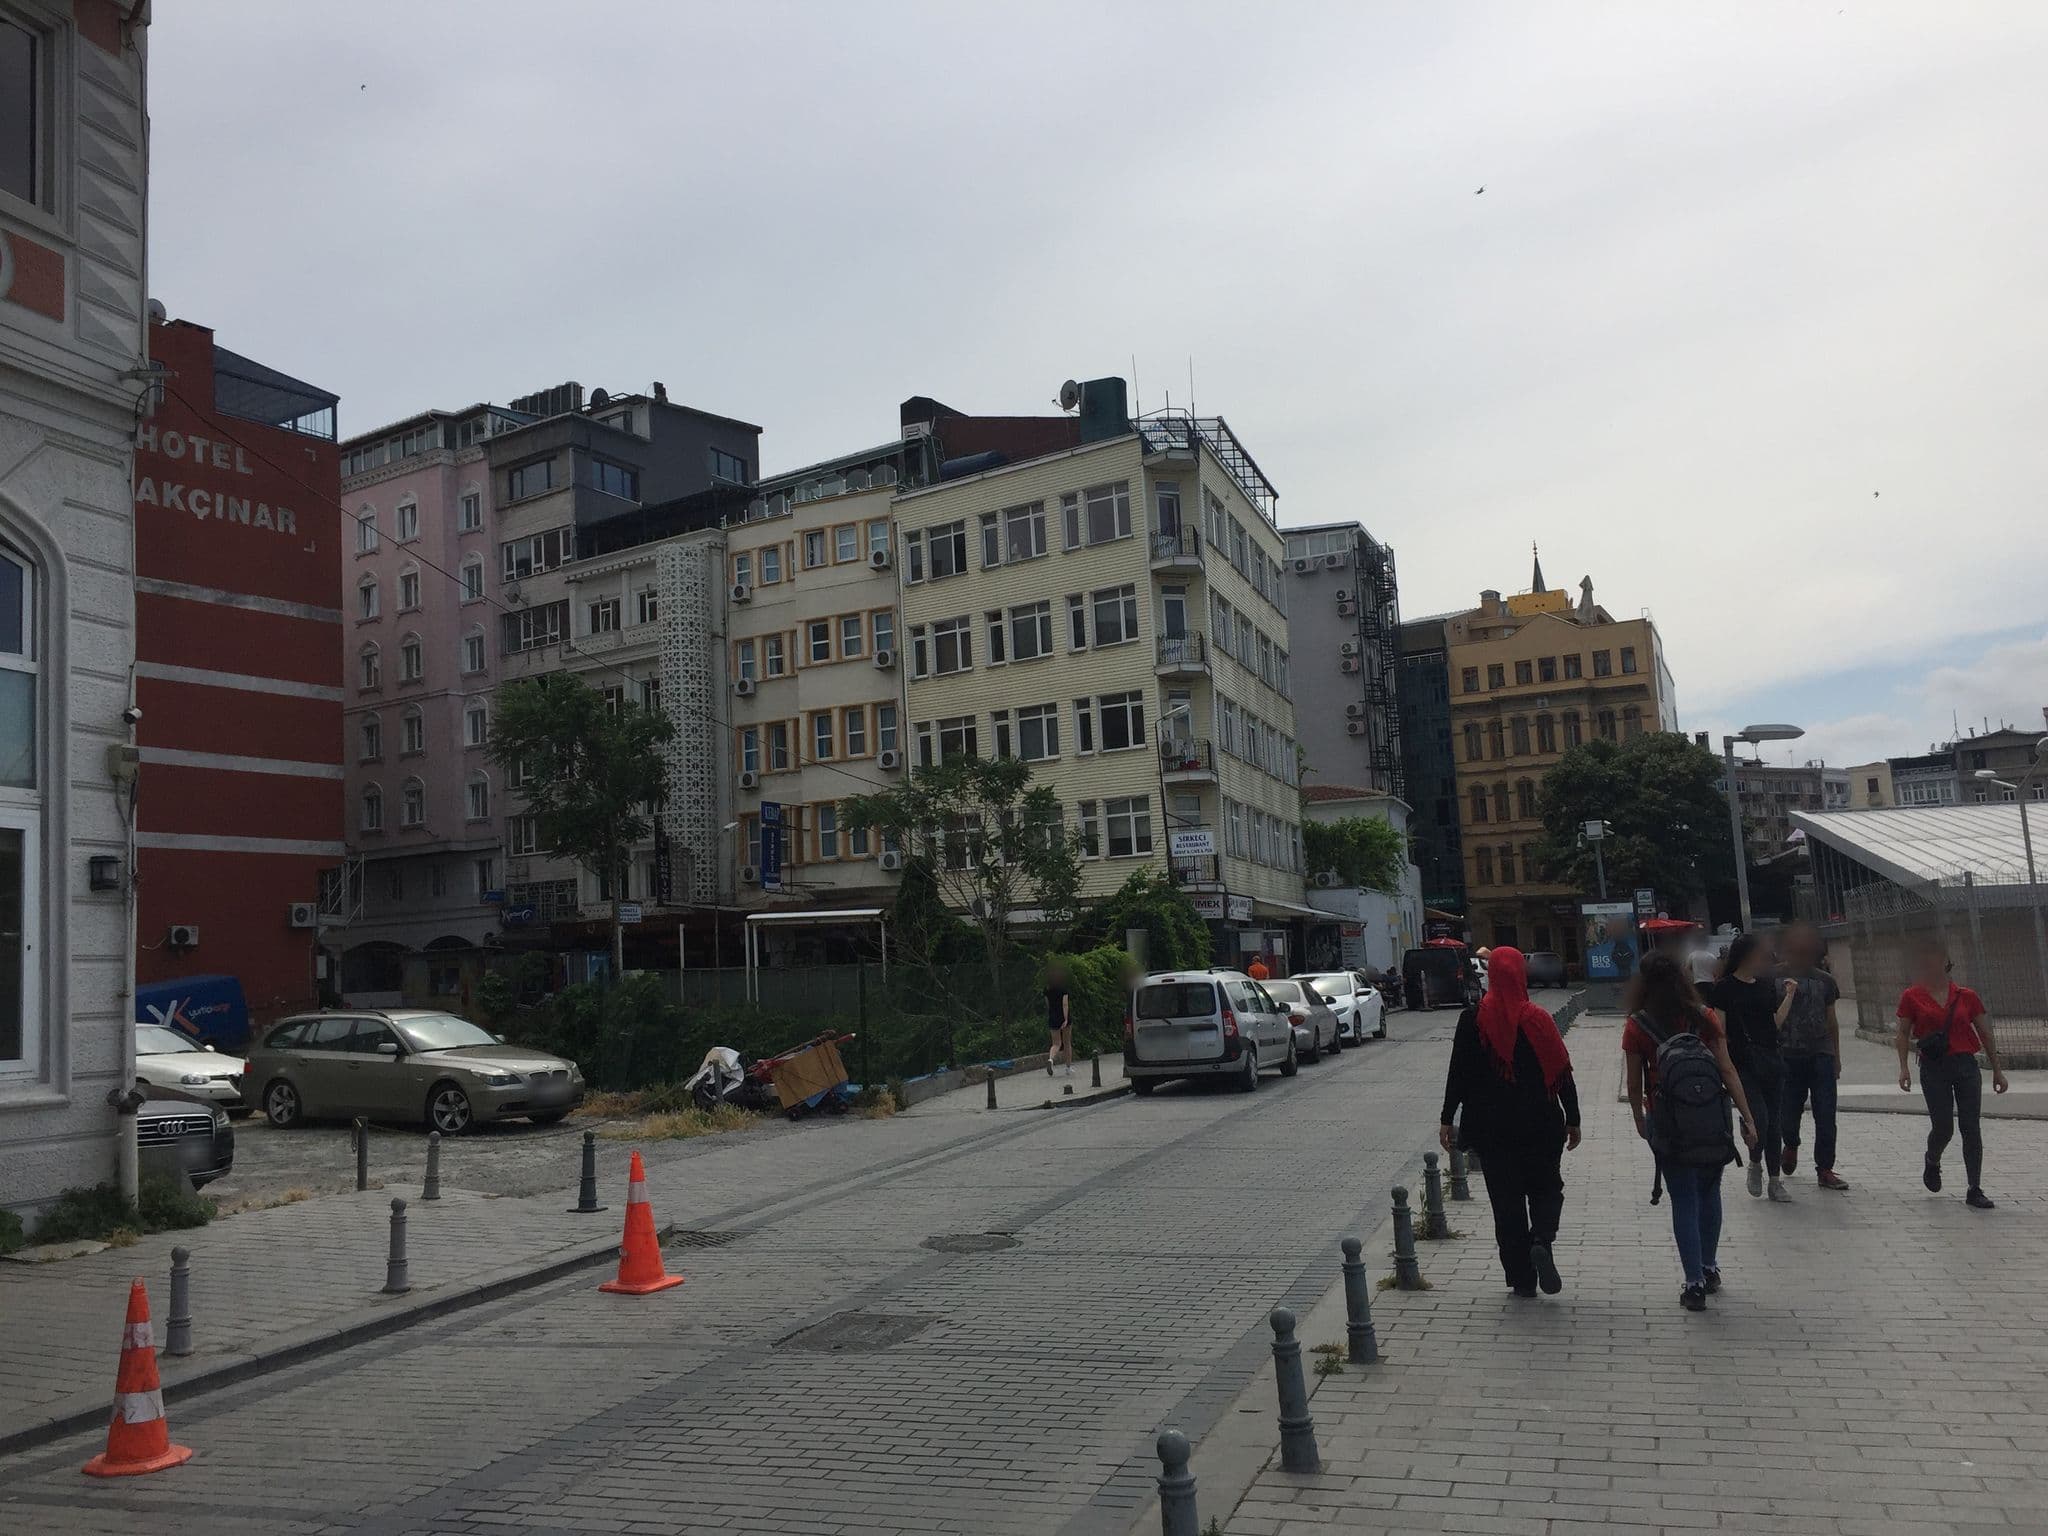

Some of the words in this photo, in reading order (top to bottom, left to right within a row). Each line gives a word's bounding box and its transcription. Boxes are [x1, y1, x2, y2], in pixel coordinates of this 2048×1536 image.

[136, 423, 254, 476] HOTEL
[136, 476, 297, 536] AKÇINAR
[1591, 955, 1611, 963] BIG
